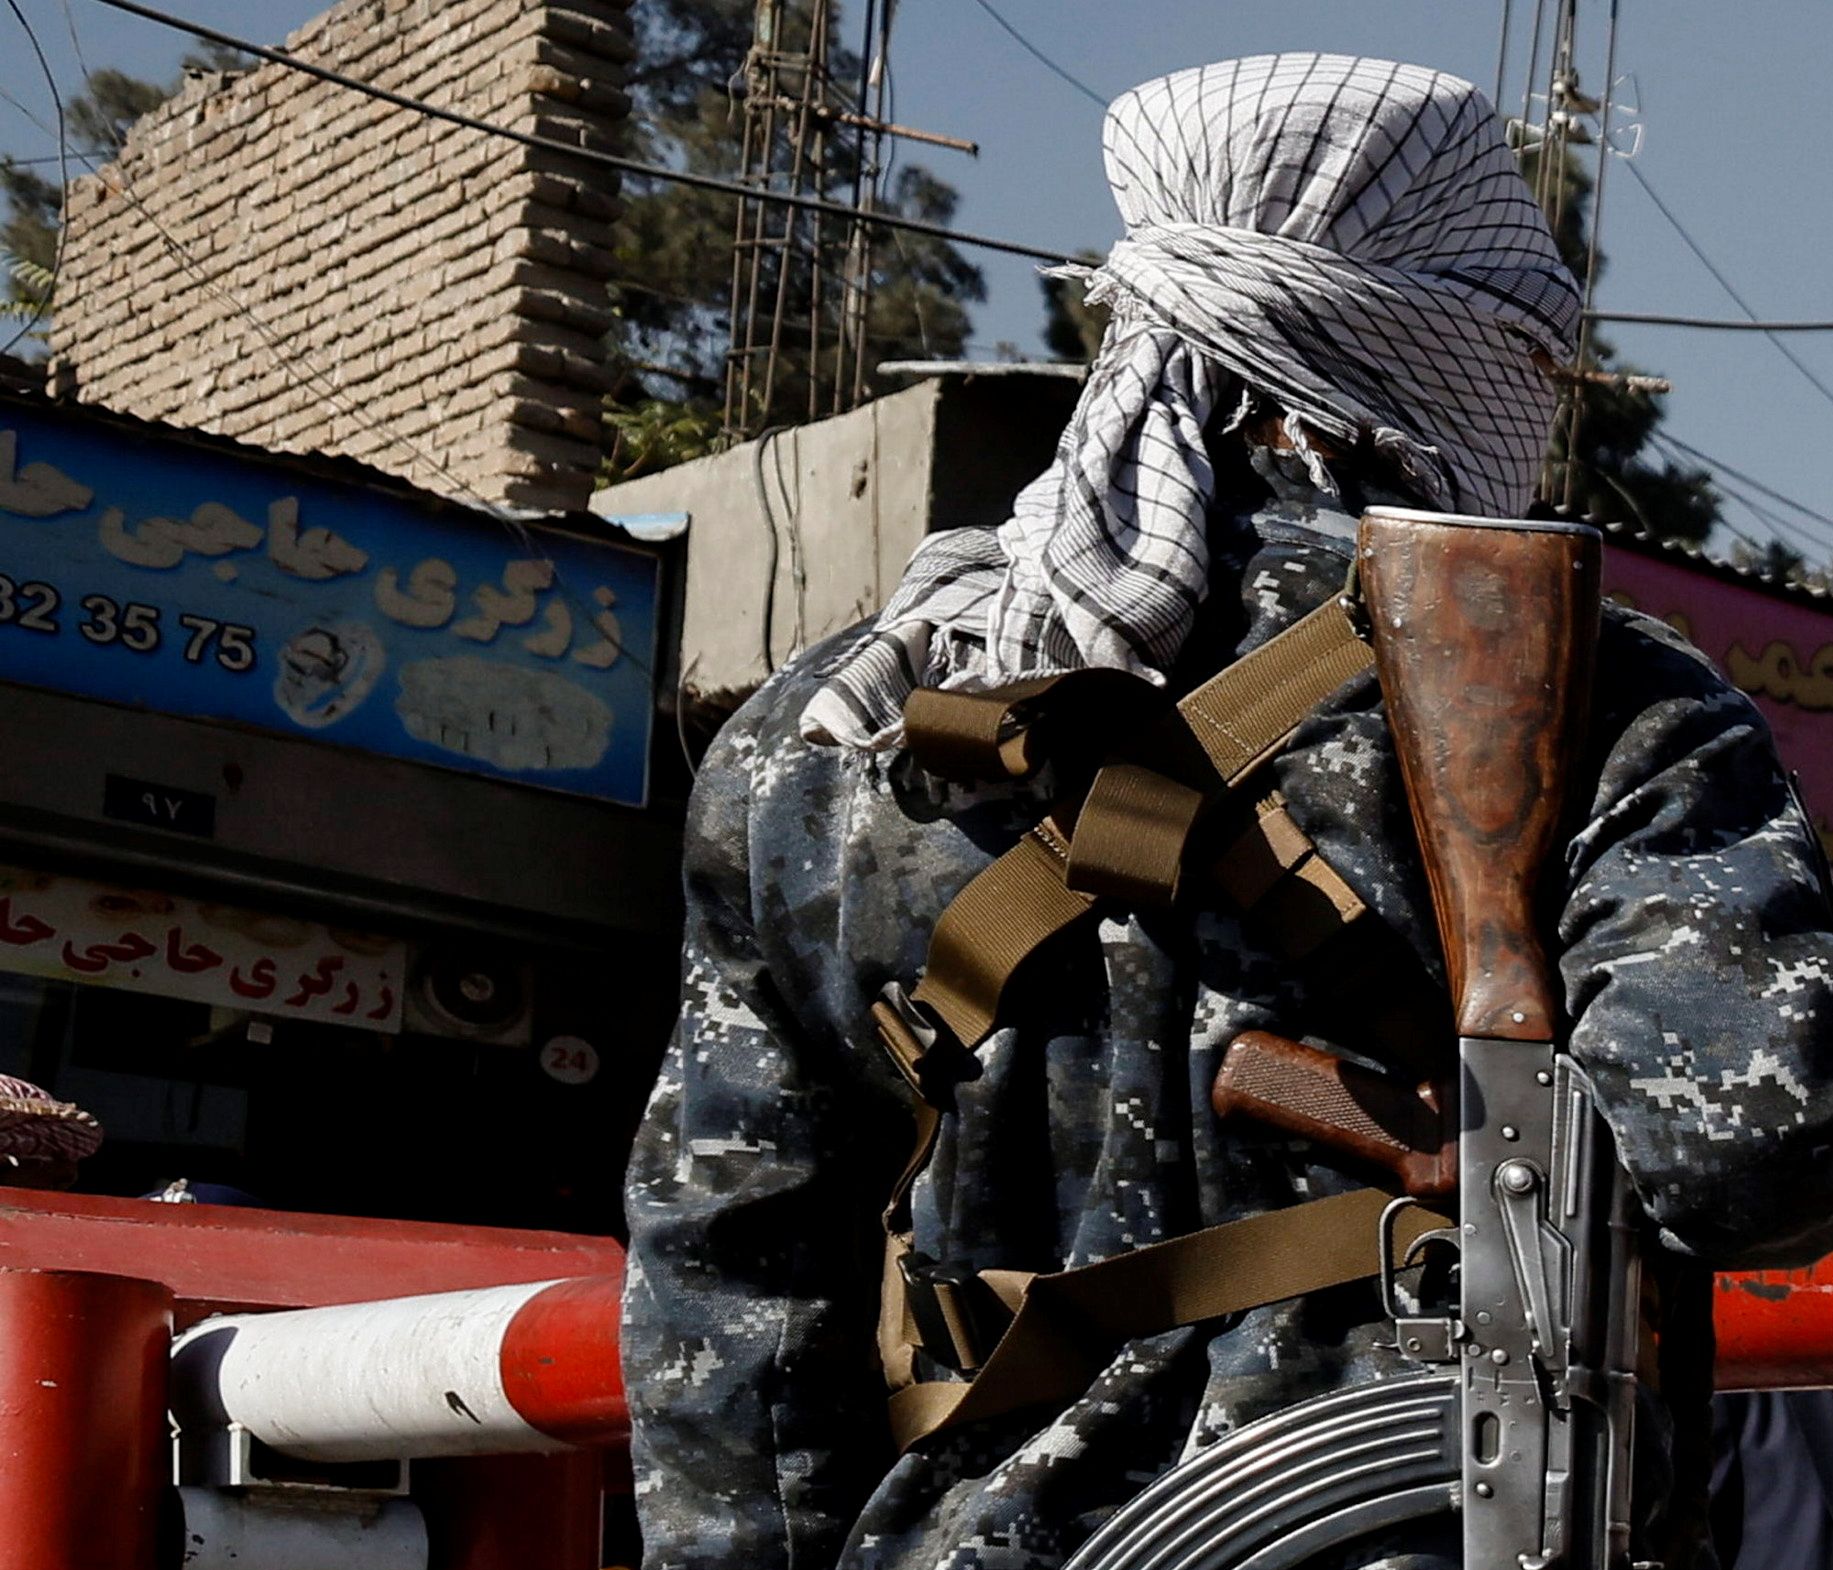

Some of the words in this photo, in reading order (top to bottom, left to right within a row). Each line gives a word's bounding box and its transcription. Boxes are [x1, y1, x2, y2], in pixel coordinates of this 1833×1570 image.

[98, 496, 368, 583] حاجی
[81, 595, 160, 653] 35
[181, 614, 256, 672] 75
[375, 556, 622, 669] زرگری
[63, 927, 223, 978] حاجی
[230, 956, 394, 1019] زرگری
[549, 1047, 587, 1072] 24
